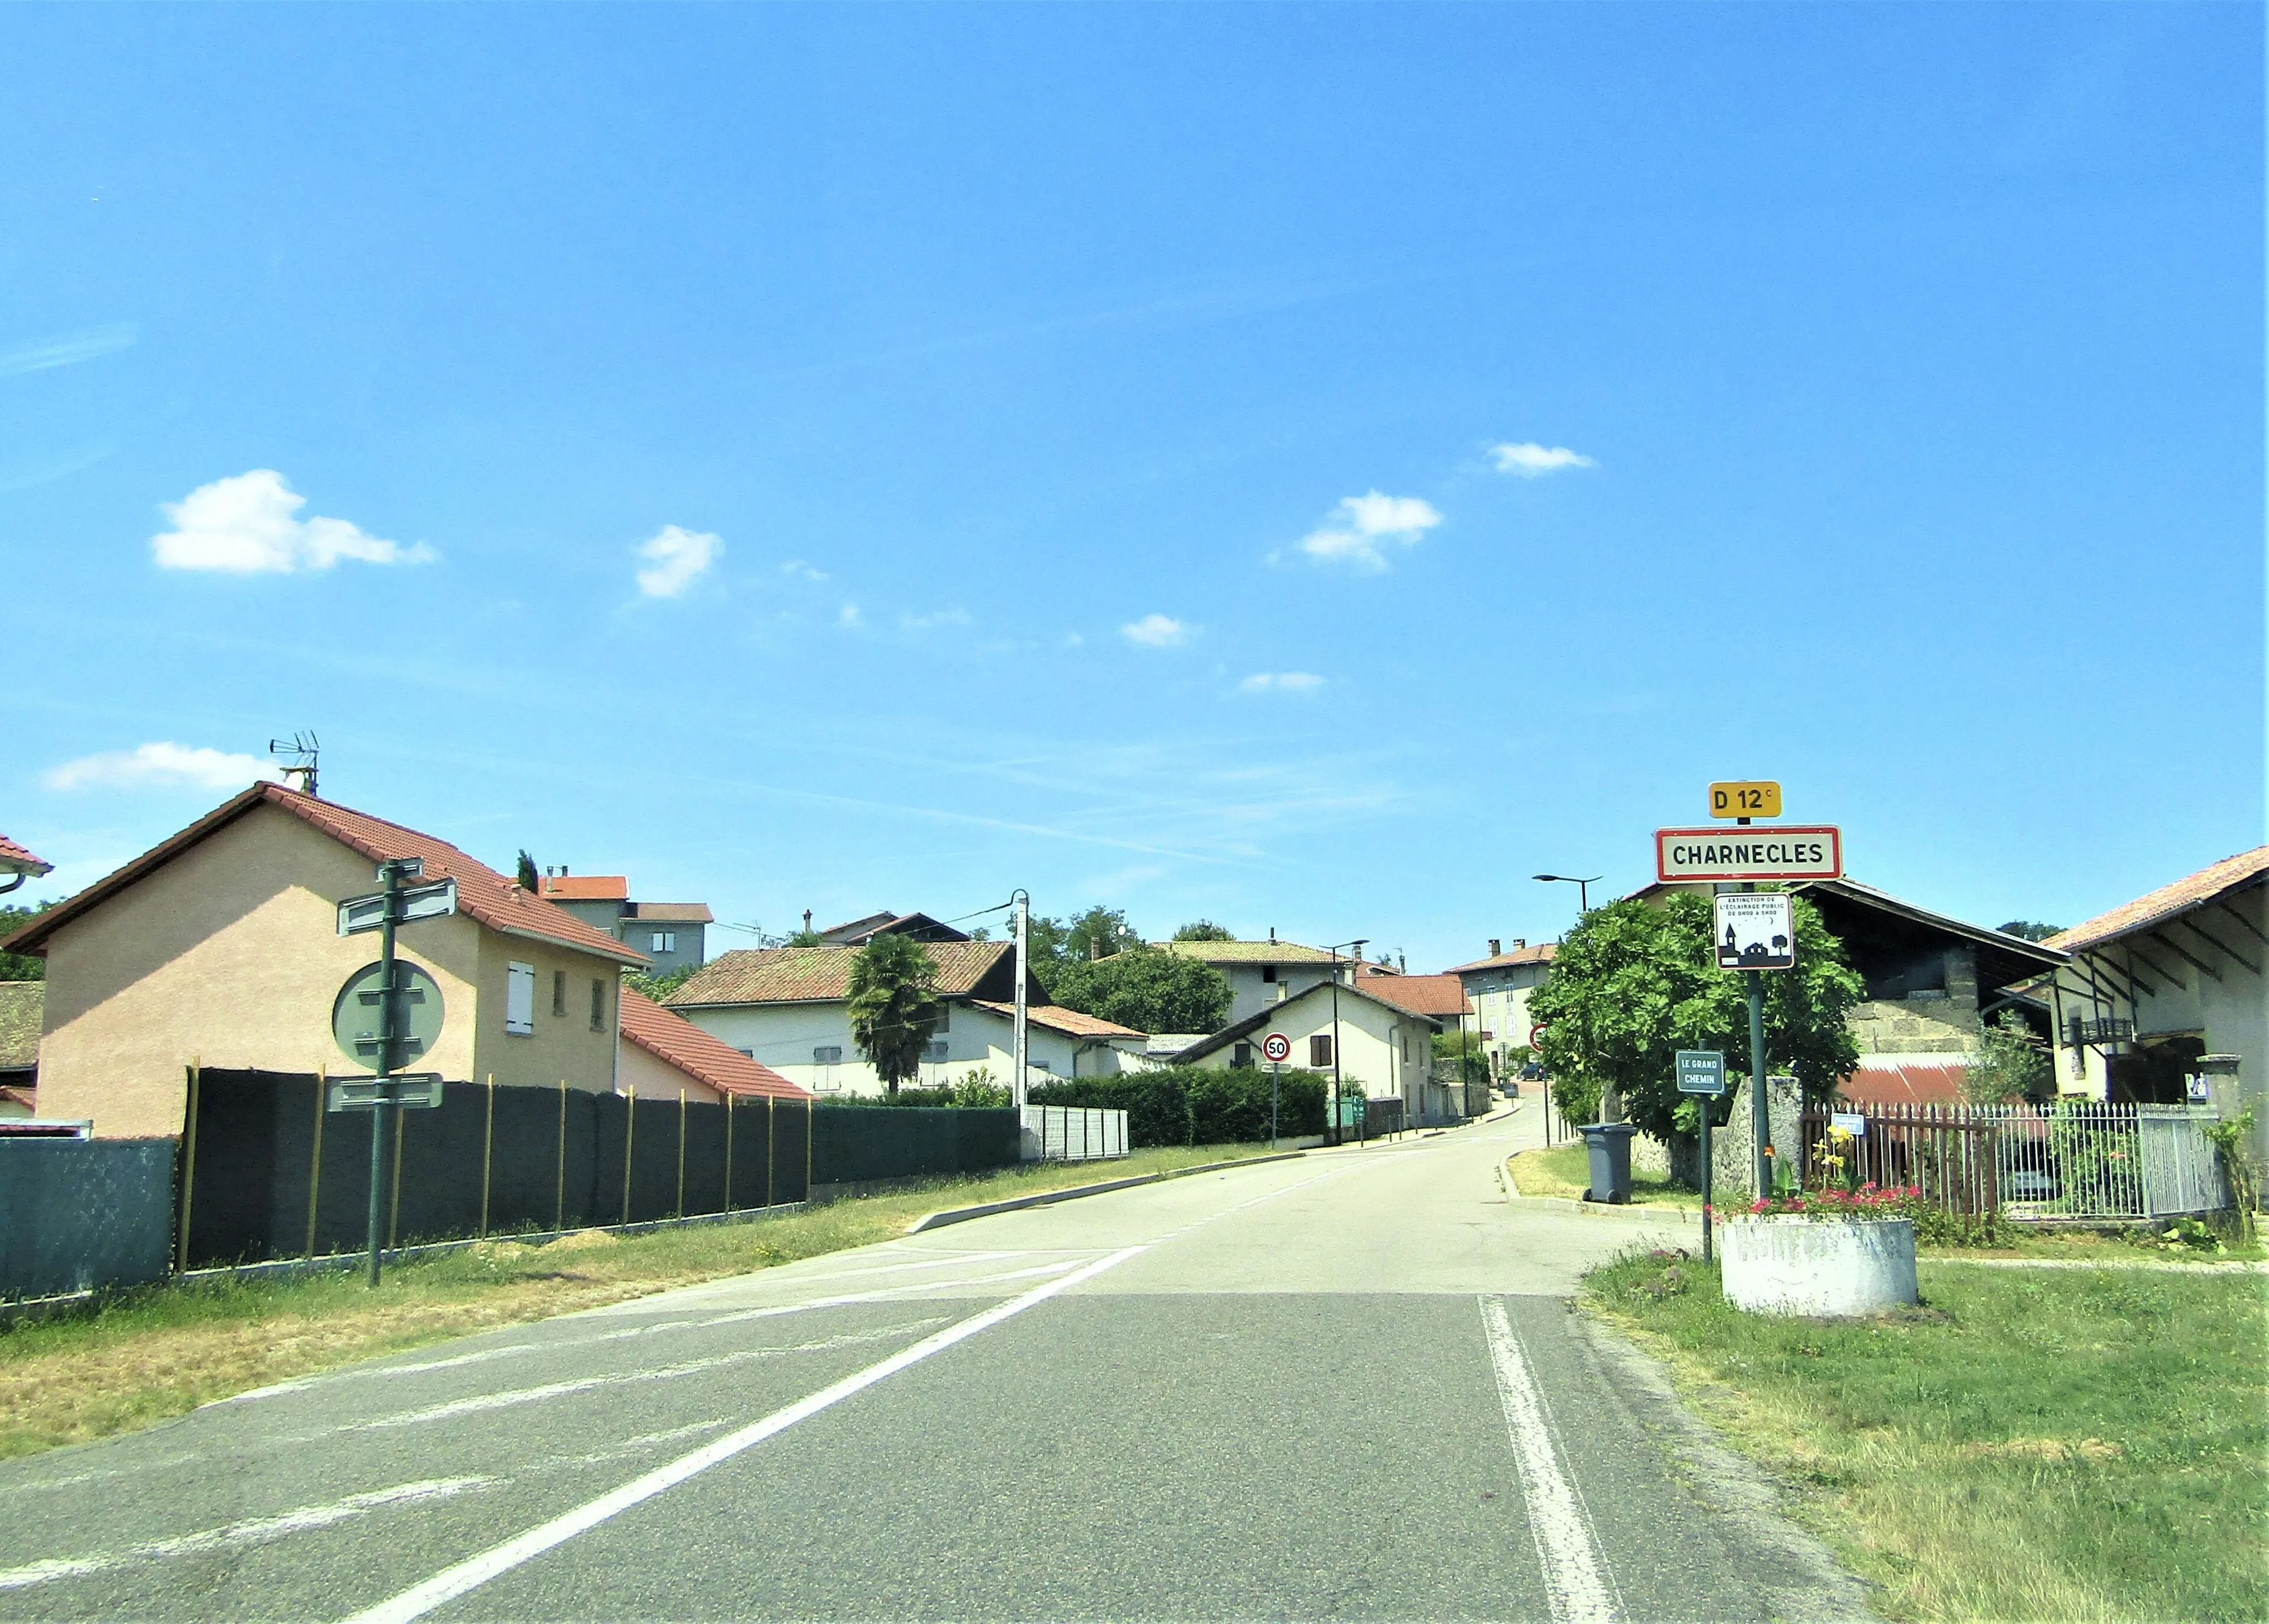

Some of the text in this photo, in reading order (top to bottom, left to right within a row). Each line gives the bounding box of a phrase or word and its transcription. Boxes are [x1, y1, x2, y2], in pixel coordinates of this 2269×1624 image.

[1714, 790, 1728, 809] D
[1673, 844, 1823, 865] CHARNECLES
[1269, 1042, 1285, 1054] 50
[1681, 1059, 1717, 1069] LE GRAND
[1685, 1074, 1715, 1084] CHEMIN
